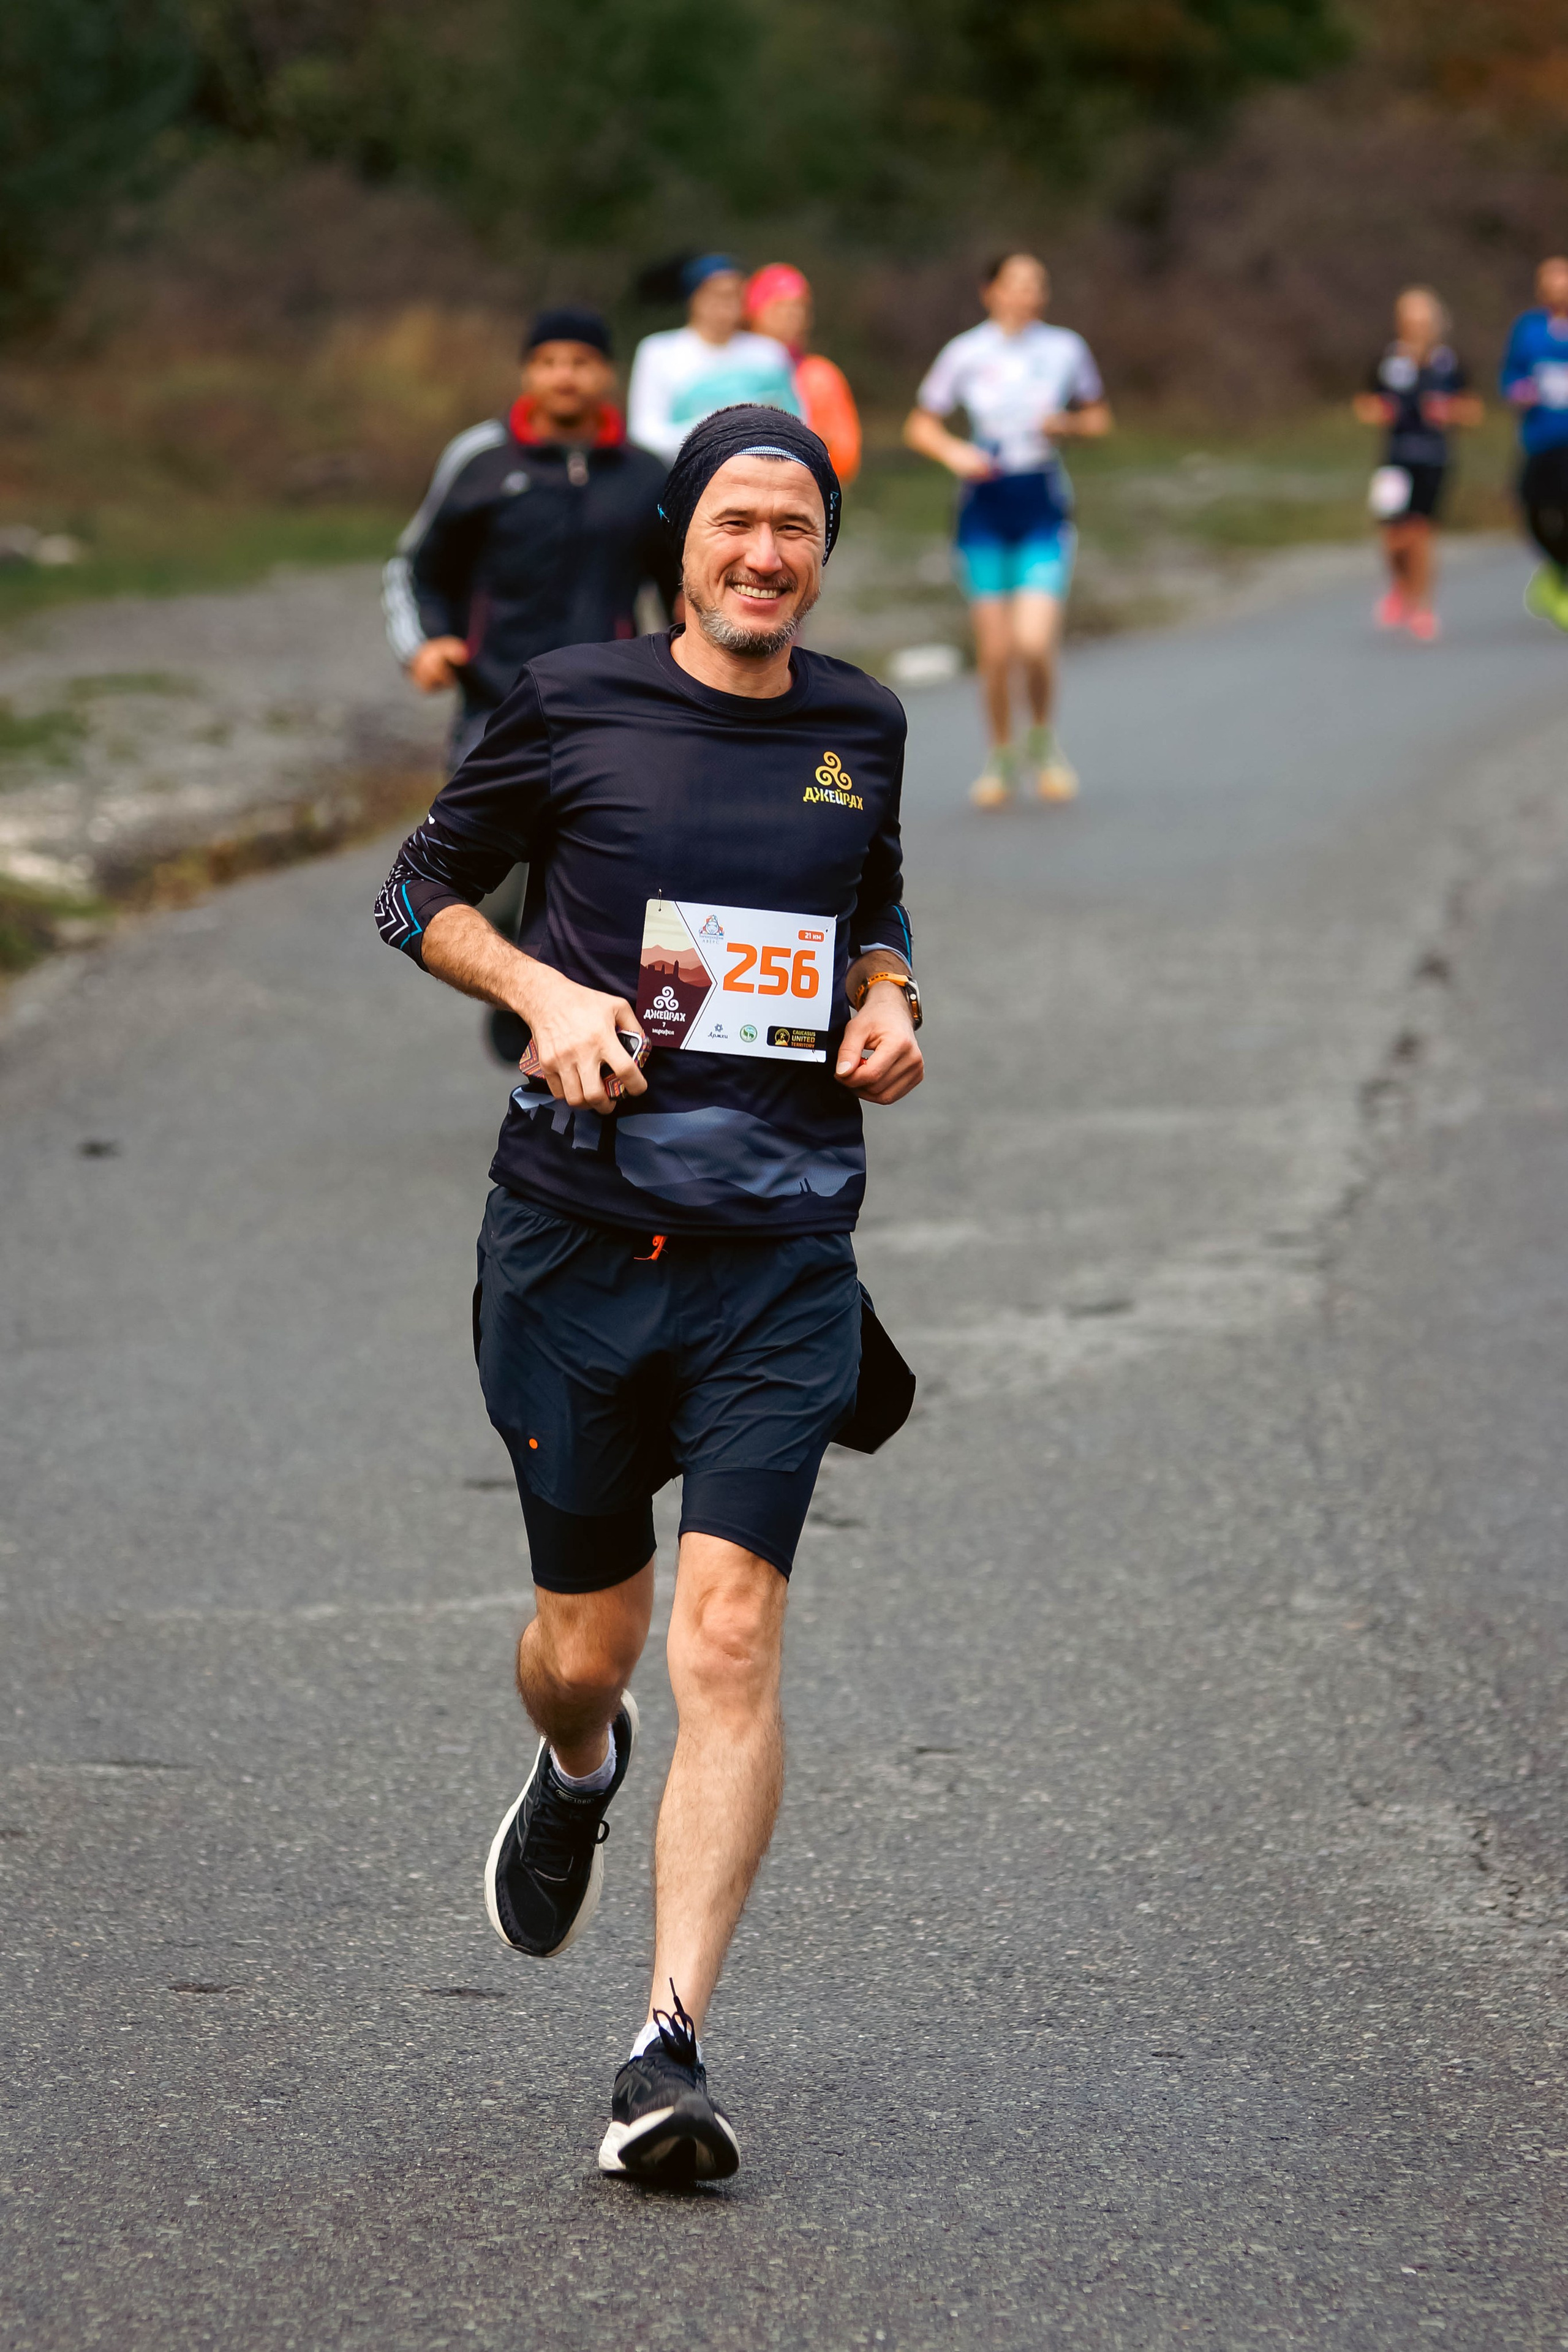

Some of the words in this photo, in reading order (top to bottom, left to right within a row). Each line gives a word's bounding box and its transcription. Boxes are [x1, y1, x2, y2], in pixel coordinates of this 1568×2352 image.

[803, 786, 863, 810] ДЖЕЙРАХ
[723, 942, 820, 999] 256
[643, 1009, 686, 1022] ДЖЕЙРАХ
[791, 1035, 816, 1043] UNITED
